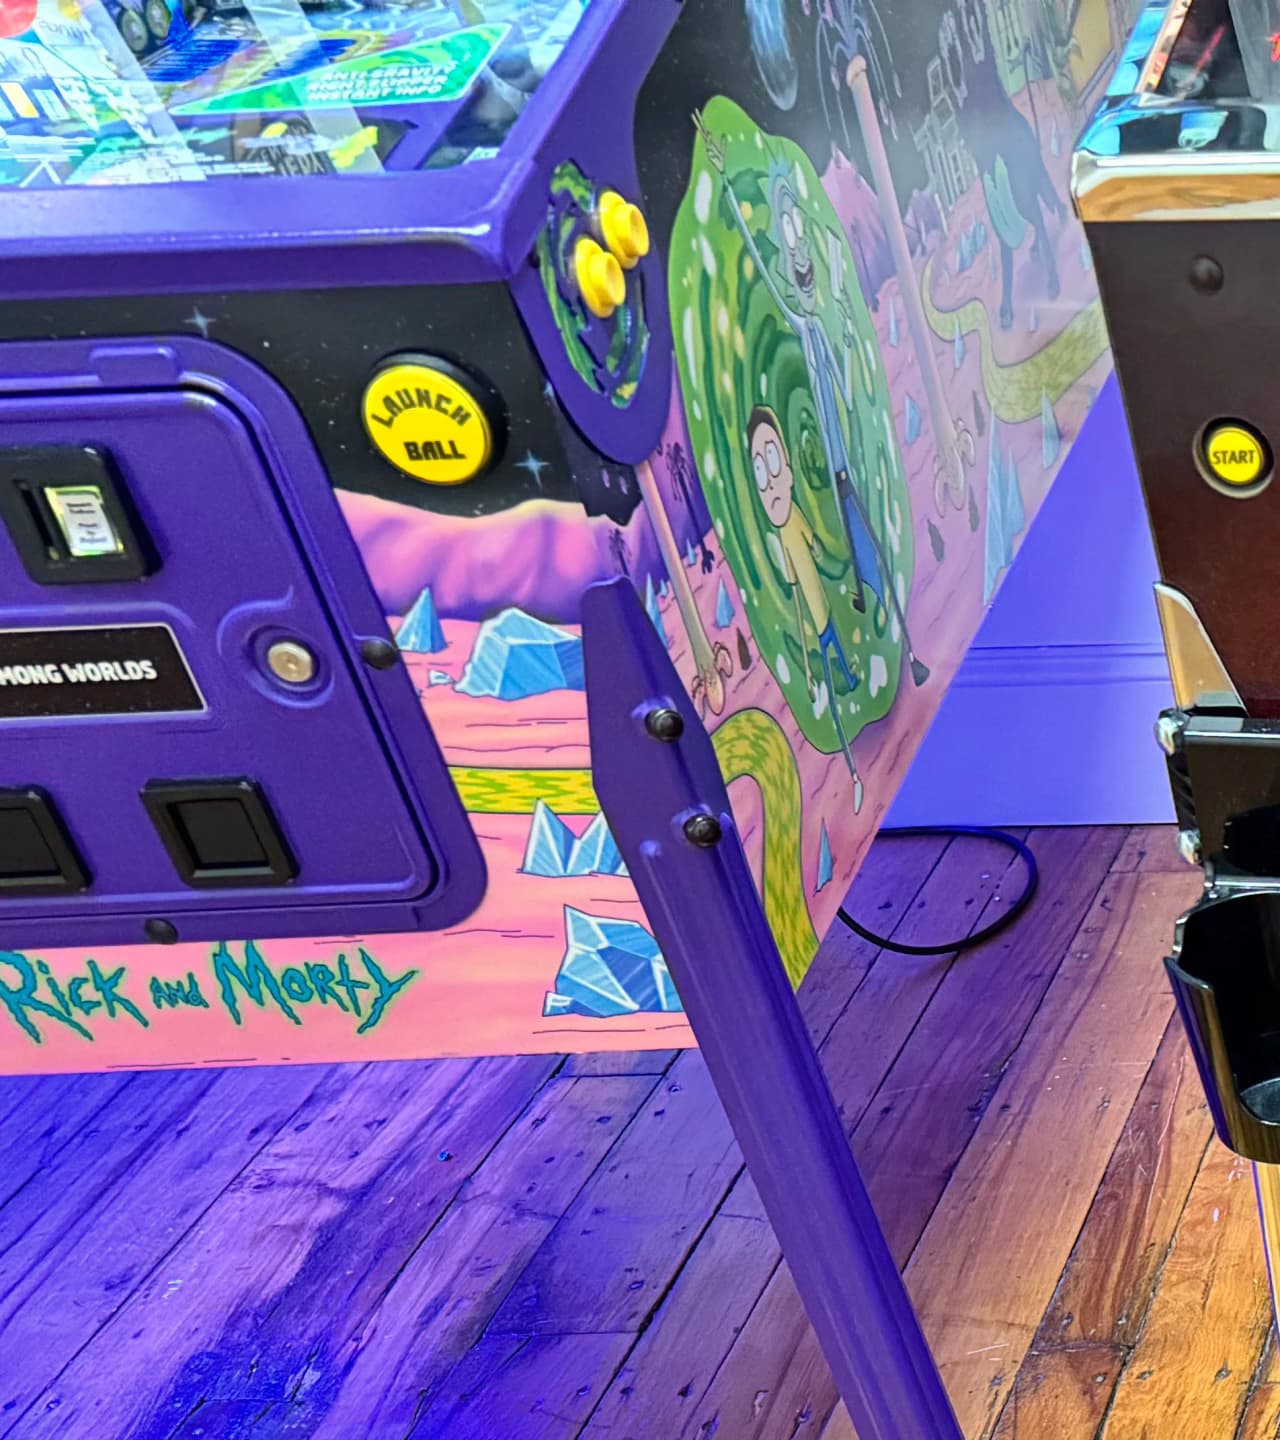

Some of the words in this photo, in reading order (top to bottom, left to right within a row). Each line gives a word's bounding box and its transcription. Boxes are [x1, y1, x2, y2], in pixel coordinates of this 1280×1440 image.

[371, 387, 472, 429] LAUNCH
[403, 440, 467, 461] BALL
[1212, 449, 1256, 465] START
[60, 660, 158, 684] WORLDS
